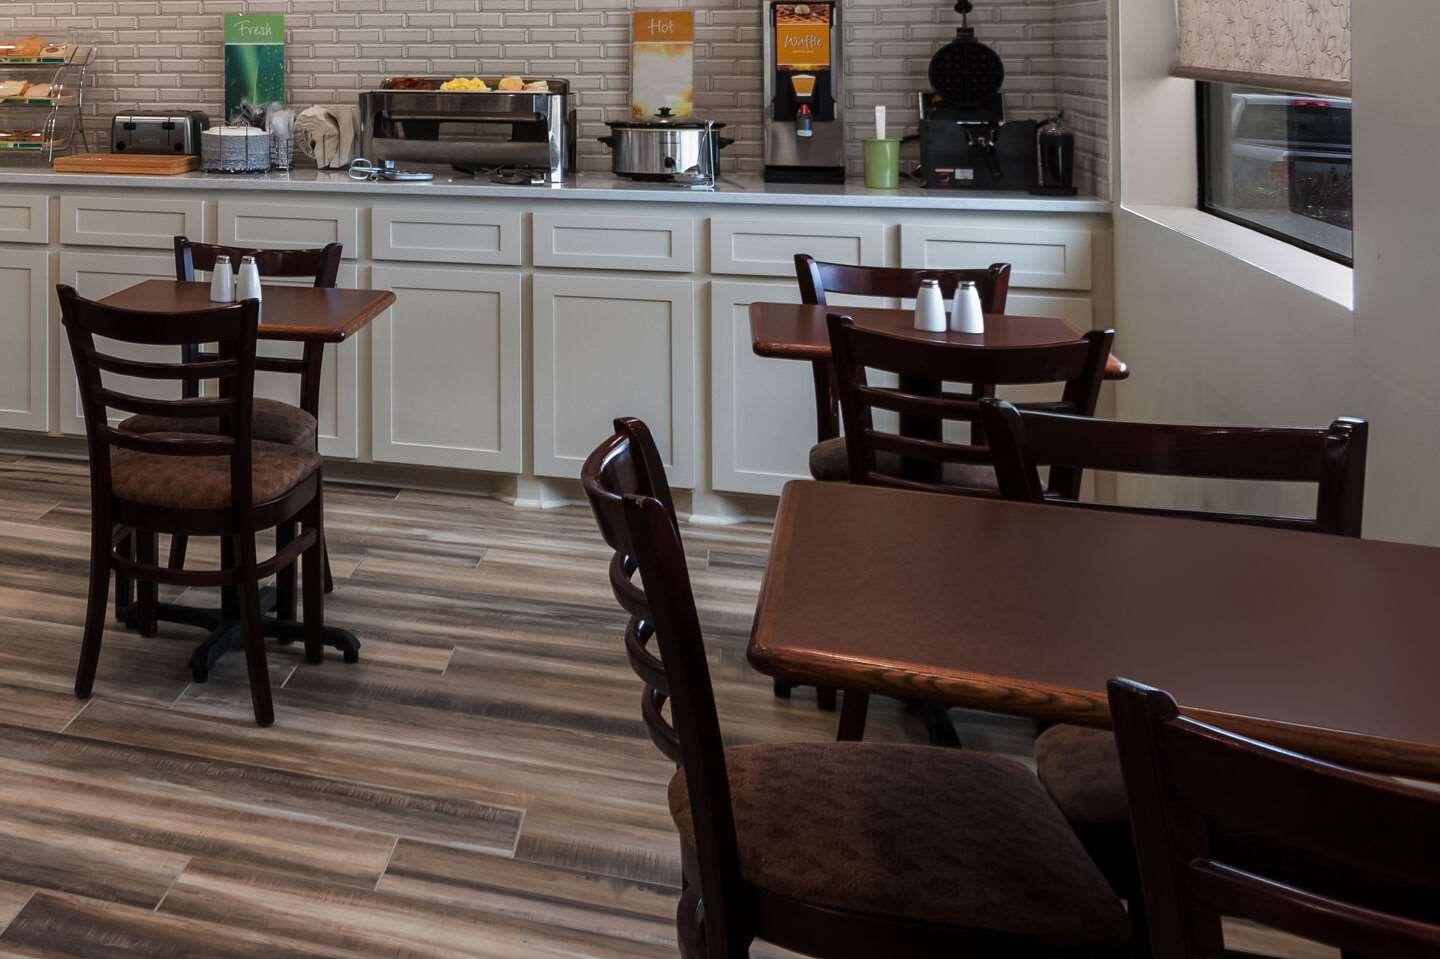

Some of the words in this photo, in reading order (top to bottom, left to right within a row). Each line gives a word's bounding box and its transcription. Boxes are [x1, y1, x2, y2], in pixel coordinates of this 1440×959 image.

[233, 19, 272, 37] Fresh
[647, 17, 675, 36] Hot
[783, 30, 824, 49] Waffle
